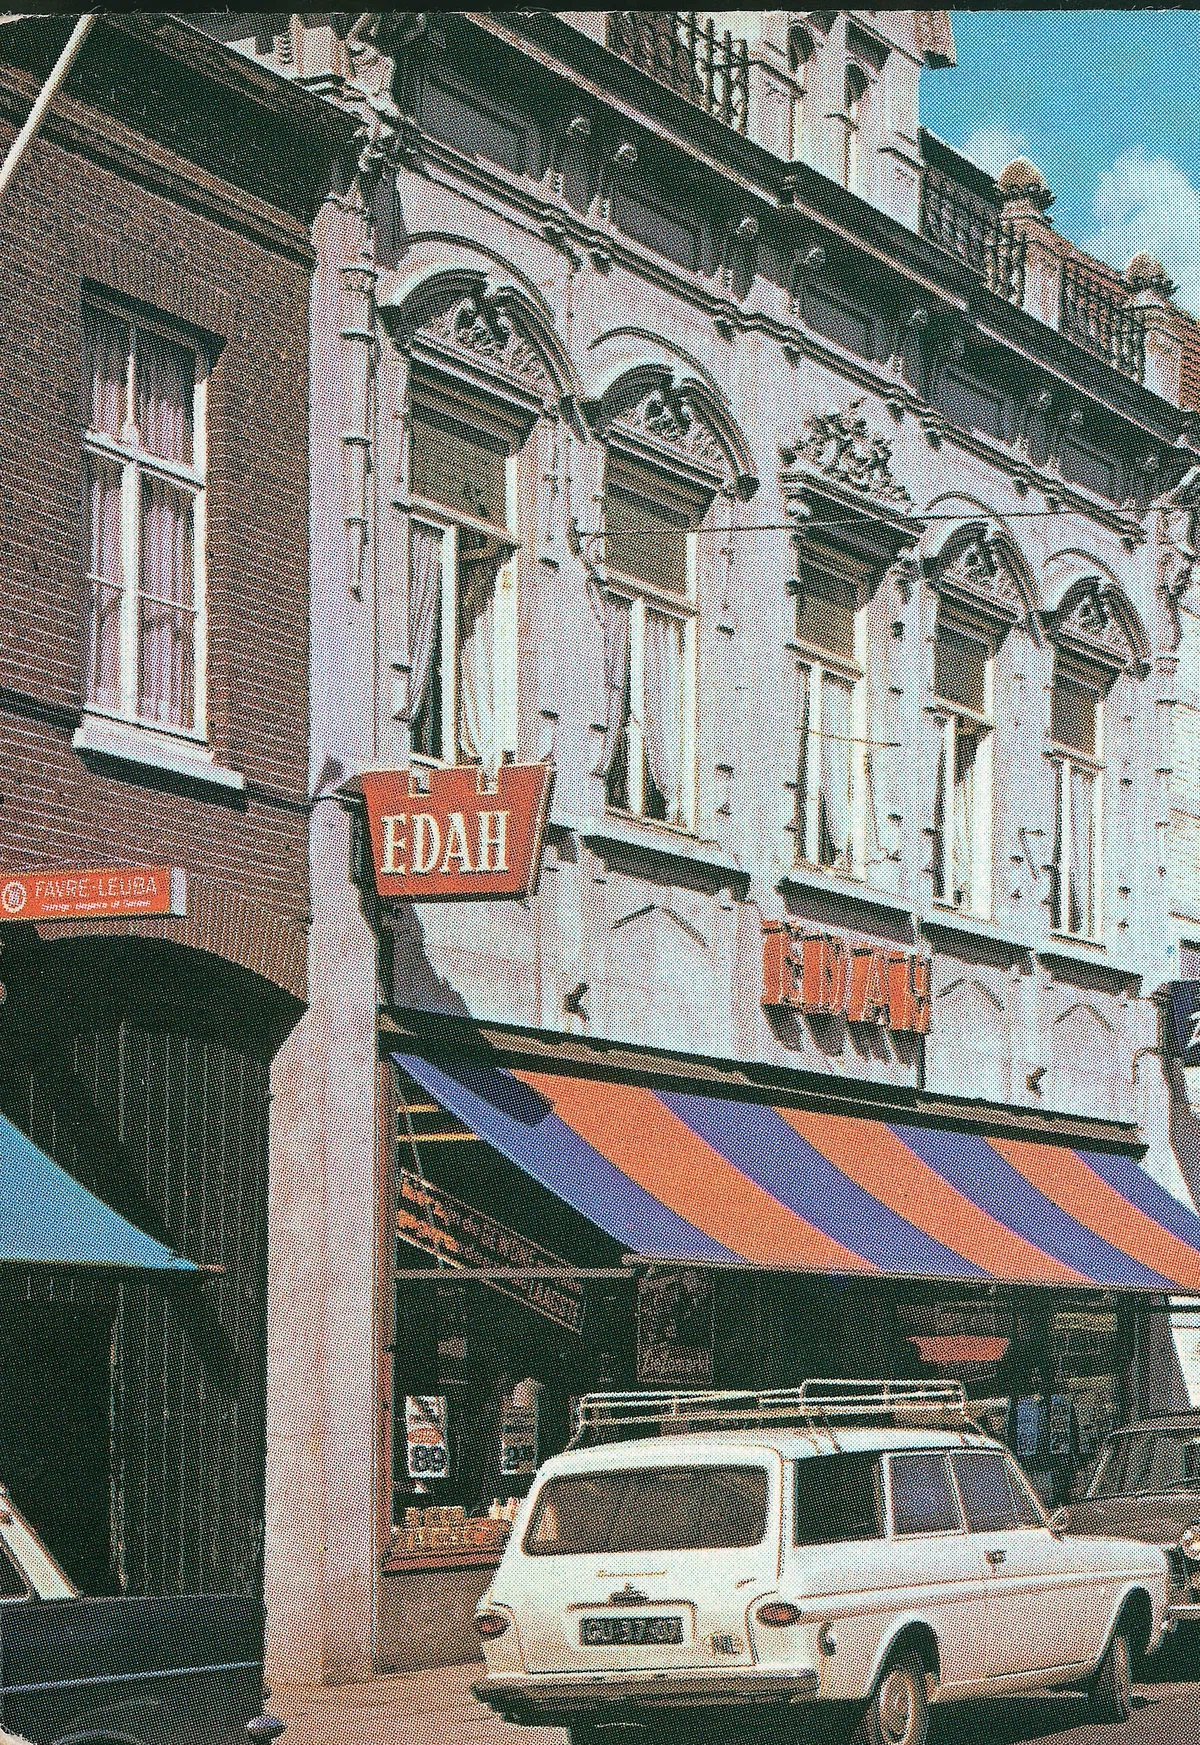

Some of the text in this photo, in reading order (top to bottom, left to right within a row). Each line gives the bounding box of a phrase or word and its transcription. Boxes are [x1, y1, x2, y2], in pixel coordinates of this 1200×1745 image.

[381, 811, 510, 876] EDAH
[35, 876, 157, 899] FAVRE-LEUBA
[761, 921, 931, 1033] EDAH
[411, 1445, 445, 1473] 89
